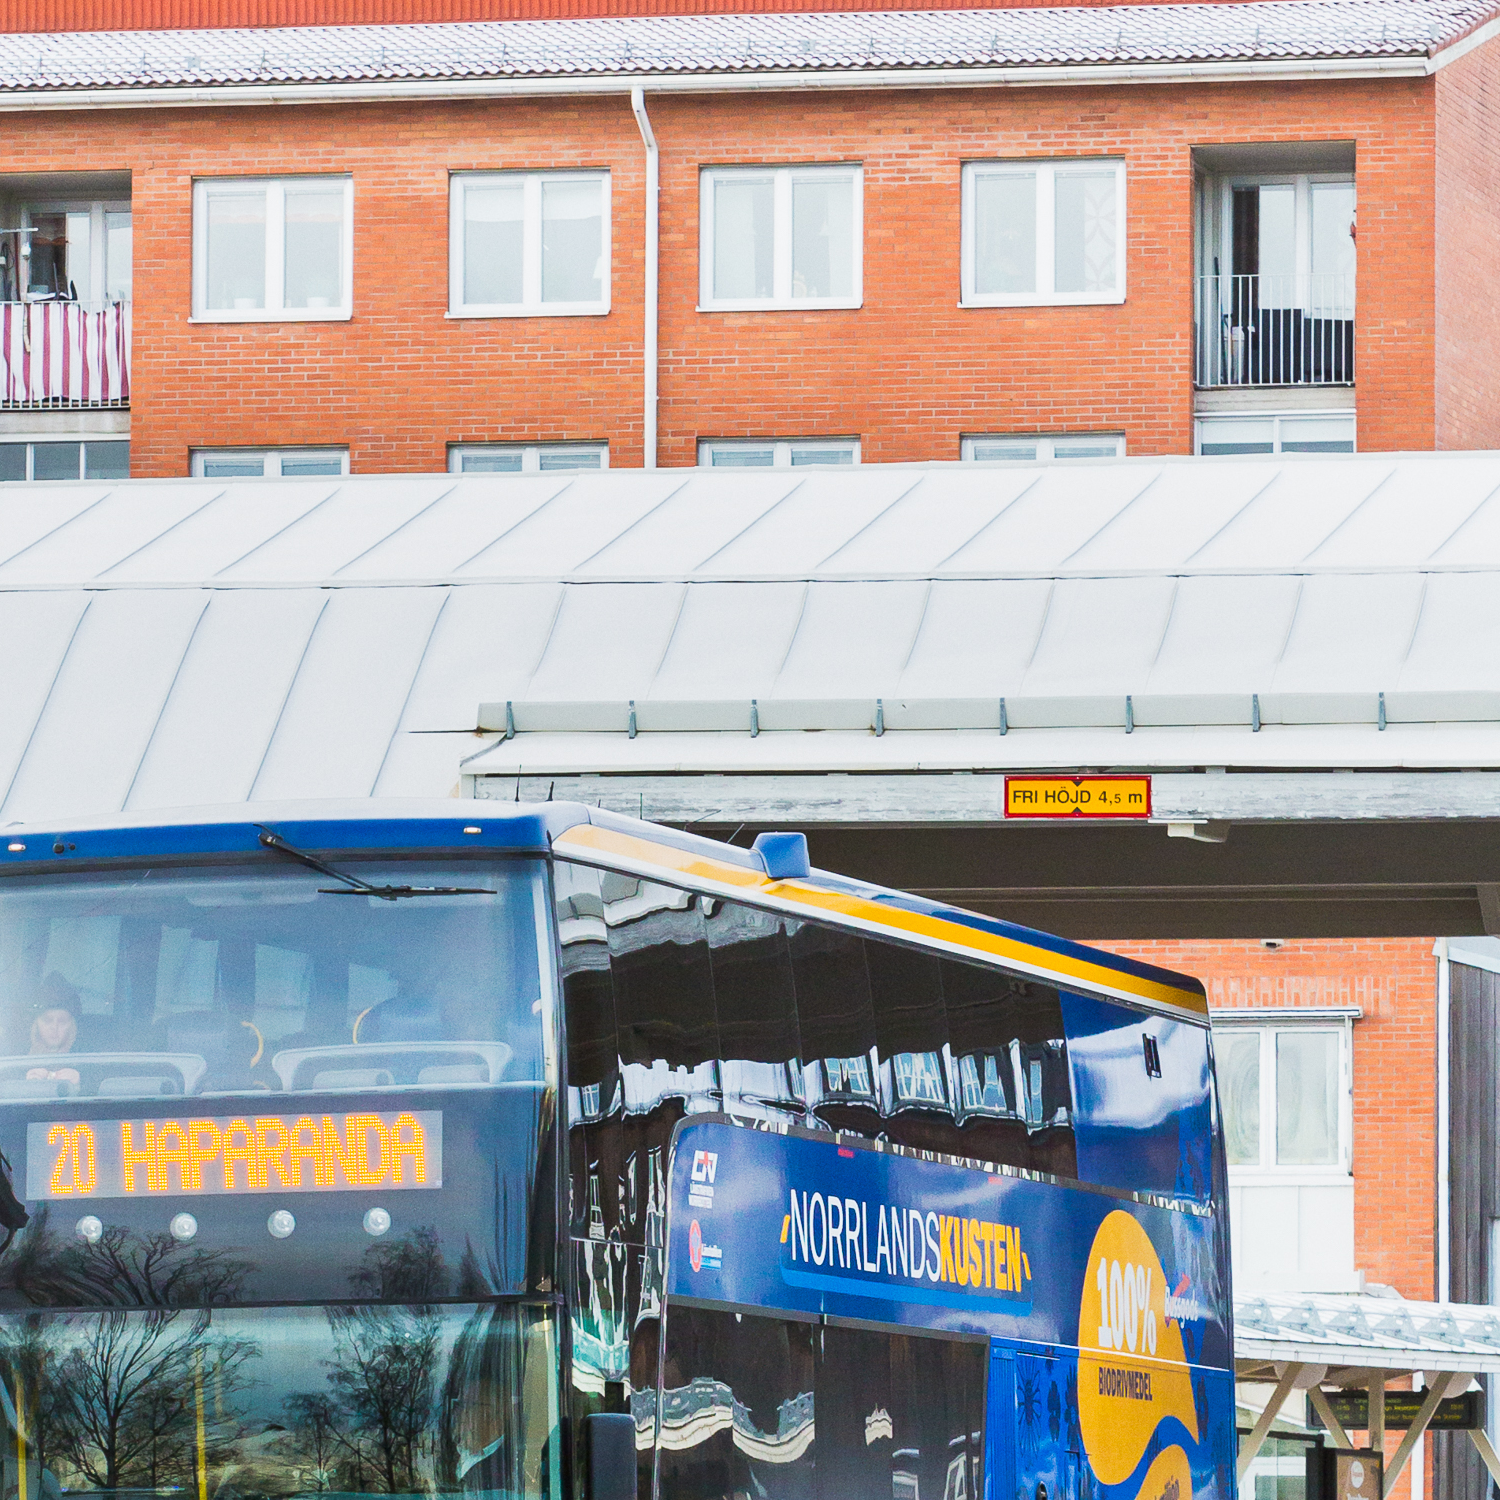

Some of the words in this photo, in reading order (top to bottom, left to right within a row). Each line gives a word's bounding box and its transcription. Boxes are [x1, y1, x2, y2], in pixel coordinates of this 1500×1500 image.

[1013, 790, 1038, 803] FRI
[1045, 786, 1091, 804] HÖJD
[1098, 790, 1122, 806] 4,5
[1128, 792, 1143, 804] m
[48, 1124, 96, 1194] 20
[121, 1114, 427, 1192] HAPARANDA
[1097, 1257, 1157, 1356] 100%
[1098, 1366, 1153, 1402] BIODRIVMEDEL
